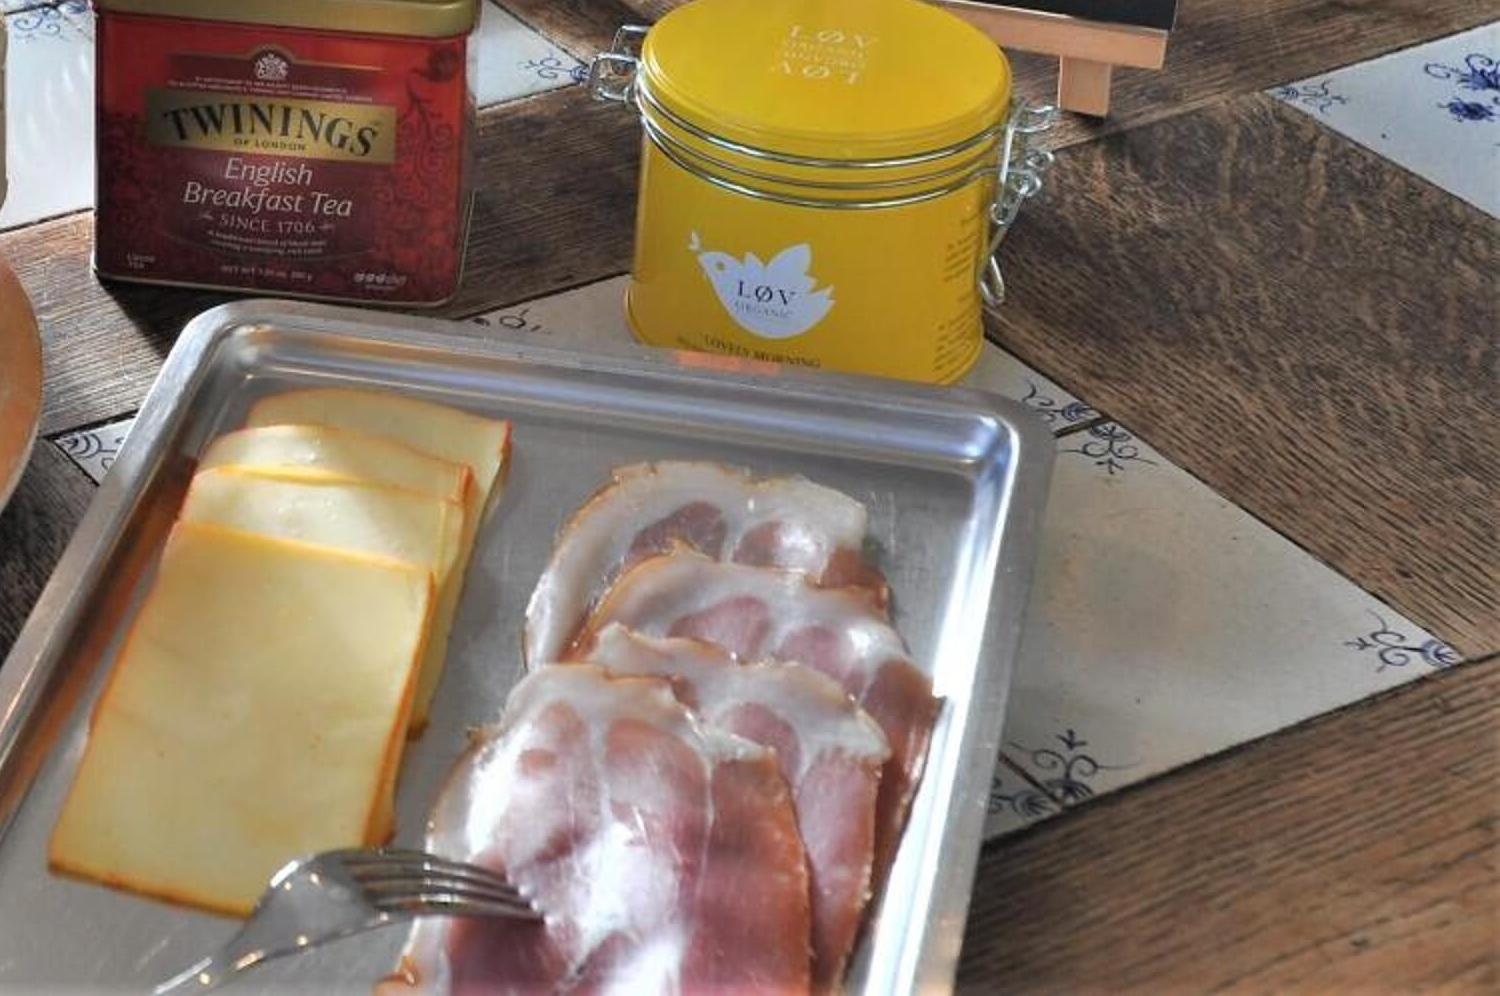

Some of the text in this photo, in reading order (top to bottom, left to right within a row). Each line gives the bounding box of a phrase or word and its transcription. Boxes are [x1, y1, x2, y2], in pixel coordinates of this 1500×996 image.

[164, 103, 379, 157] TWININGS
[254, 140, 307, 152] LONDON
[224, 157, 313, 187] English
[183, 181, 353, 217] Breakfast Tea
[219, 213, 316, 235] SINCE 1706
